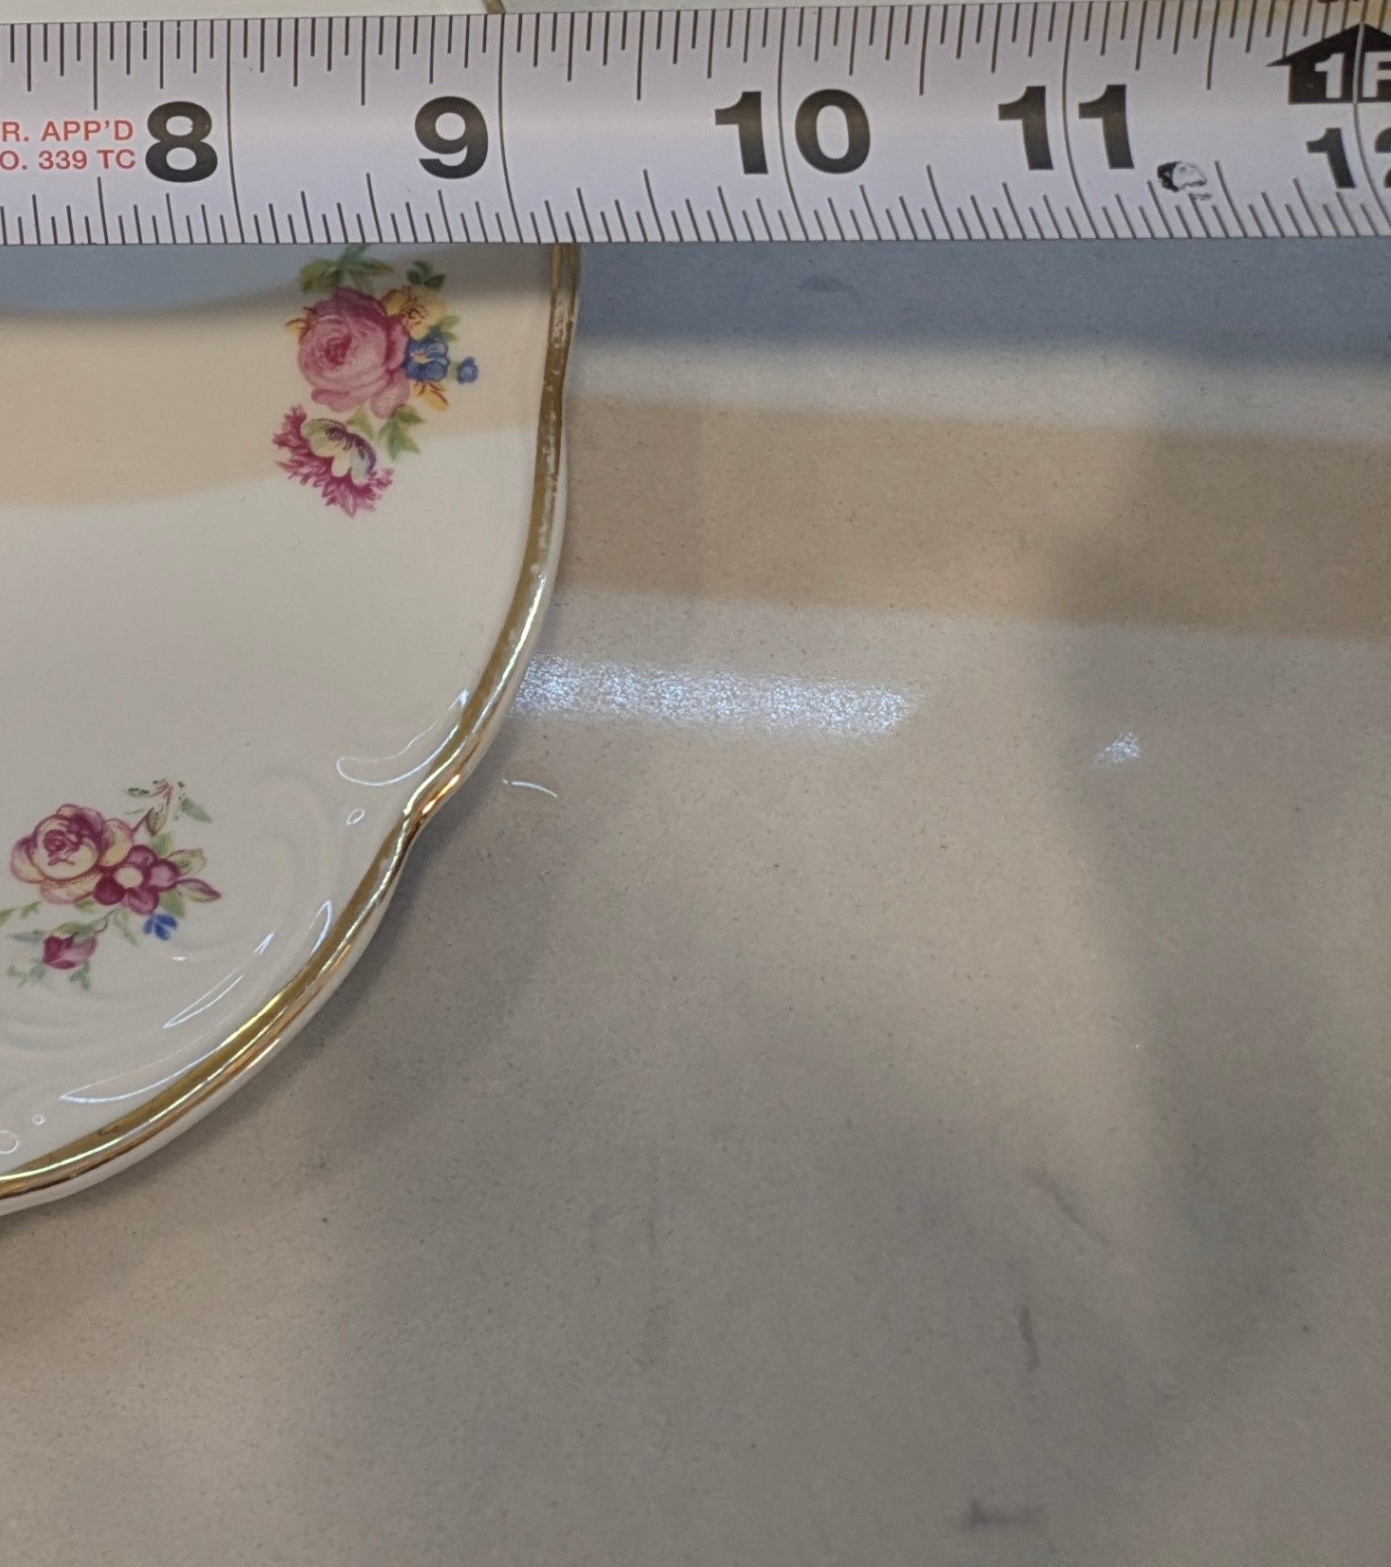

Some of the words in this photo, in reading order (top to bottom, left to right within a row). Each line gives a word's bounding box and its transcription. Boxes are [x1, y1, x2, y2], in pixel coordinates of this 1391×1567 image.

[38, 149, 88, 169] 339
[96, 149, 136, 170] TC
[145, 100, 218, 183] 8
[414, 95, 489, 179] 9
[714, 89, 871, 175] 10
[998, 83, 1135, 171] 11
